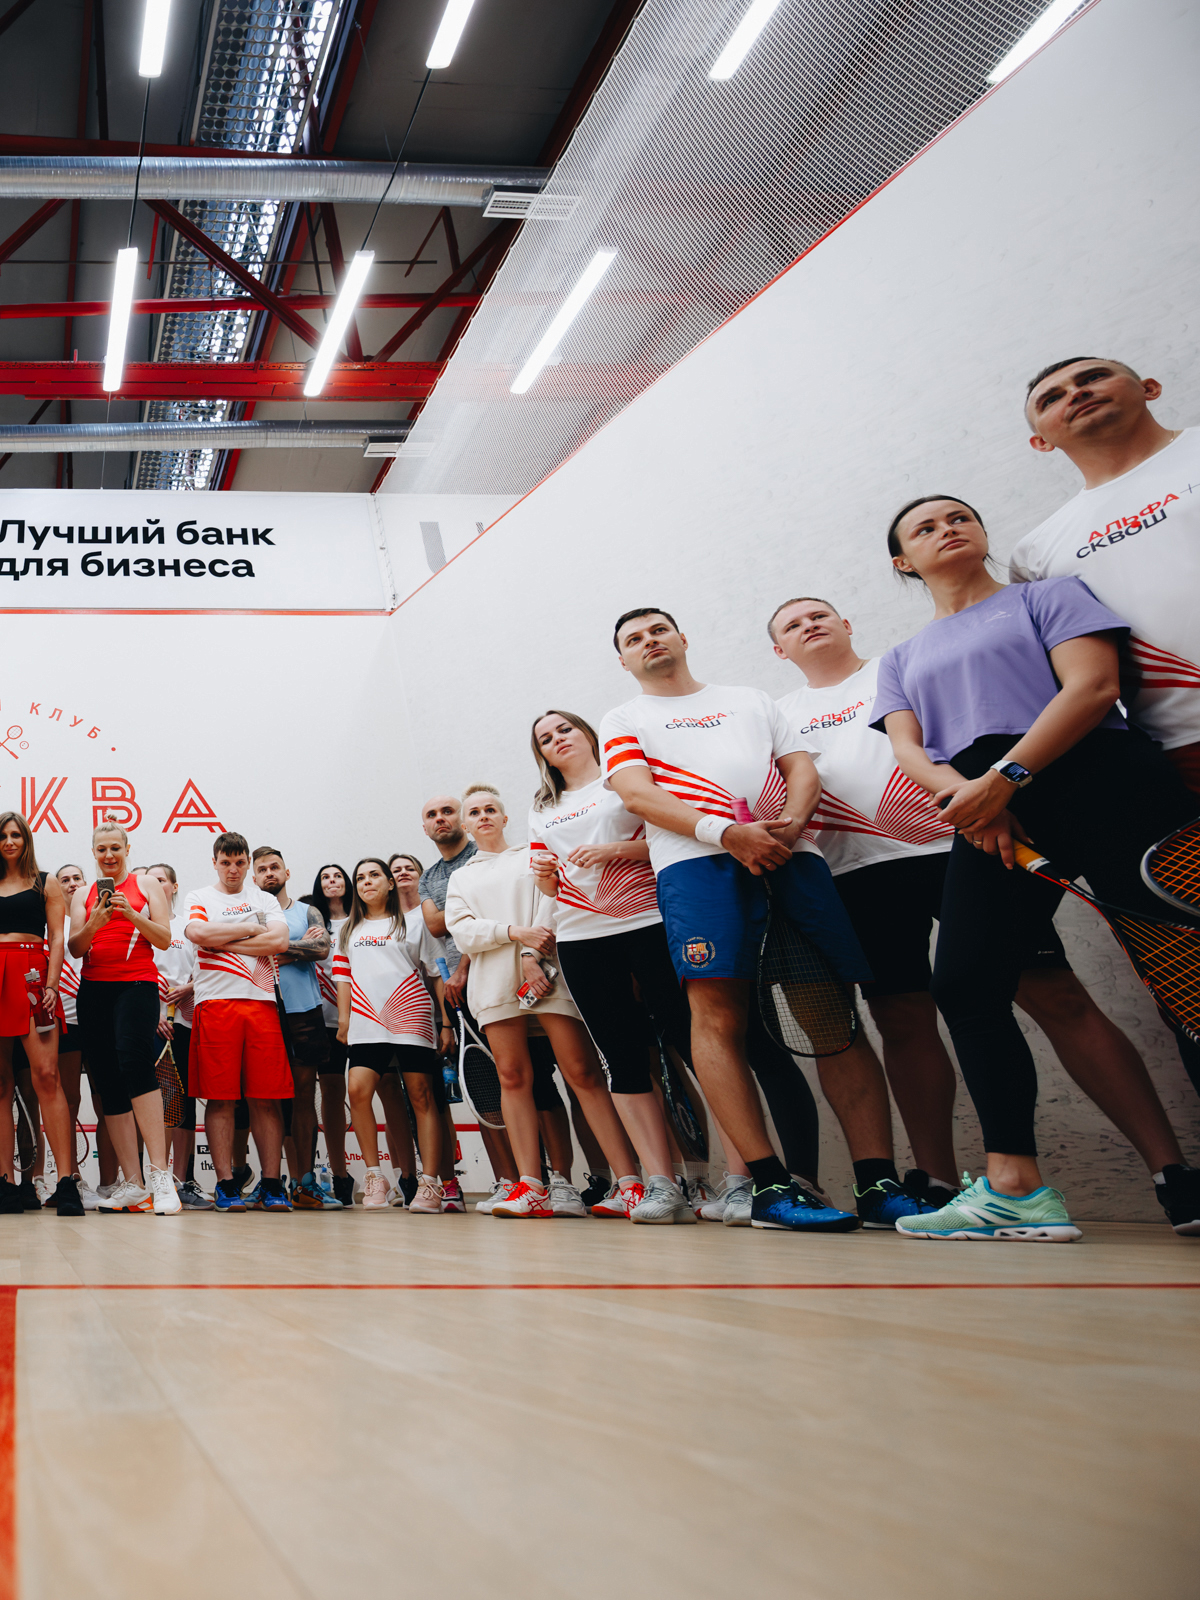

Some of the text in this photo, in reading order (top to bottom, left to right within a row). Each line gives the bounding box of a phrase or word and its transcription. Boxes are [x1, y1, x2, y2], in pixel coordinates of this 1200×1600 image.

[1088, 493, 1180, 543] АЛЬФА
[176, 520, 276, 546] банк
[1076, 508, 1167, 558] СКВОШ
[81, 551, 255, 578] бизнеса
[29, 701, 101, 739] КЛУБ
[665, 719, 722, 729] СКВОШ
[672, 712, 727, 724] АЛЬФА
[800, 711, 856, 734] СКВОШ
[809, 701, 865, 725] АЛЬФА
[226, 902, 250, 911] АЛЬФ
